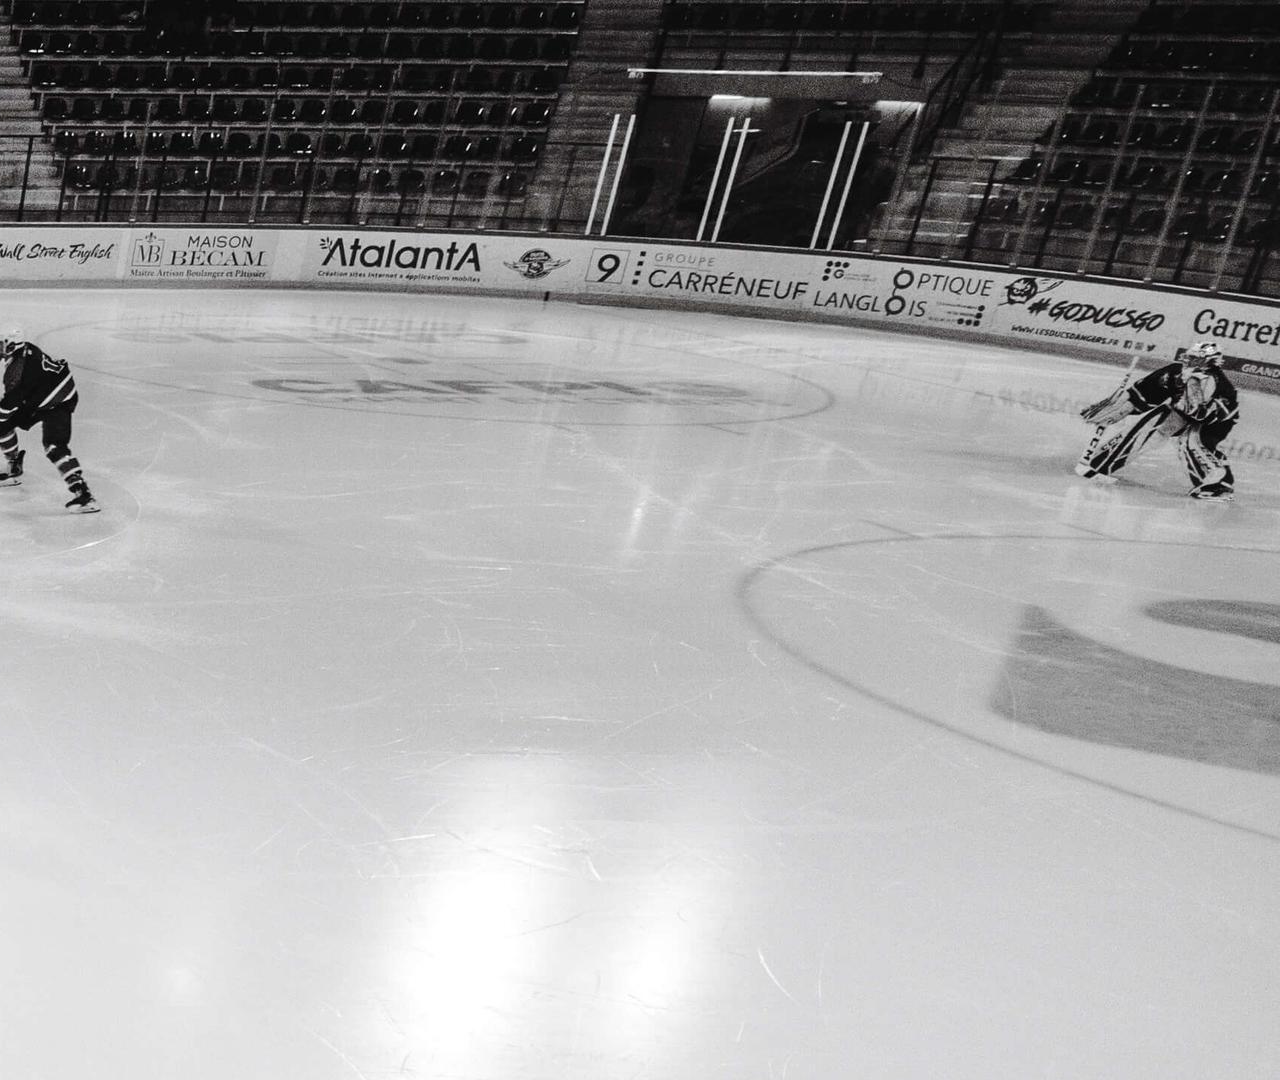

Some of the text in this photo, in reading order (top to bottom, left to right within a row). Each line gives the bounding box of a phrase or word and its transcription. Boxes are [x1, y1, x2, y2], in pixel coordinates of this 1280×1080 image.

[27, 243, 66, 259] Street
[68, 243, 115, 264] English
[187, 236, 253, 248] MAISON
[597, 253, 621, 283] 9
[654, 251, 717, 267] GROUPE
[647, 268, 809, 300] CARRÉNEUF
[893, 268, 995, 297] OPTIQUE
